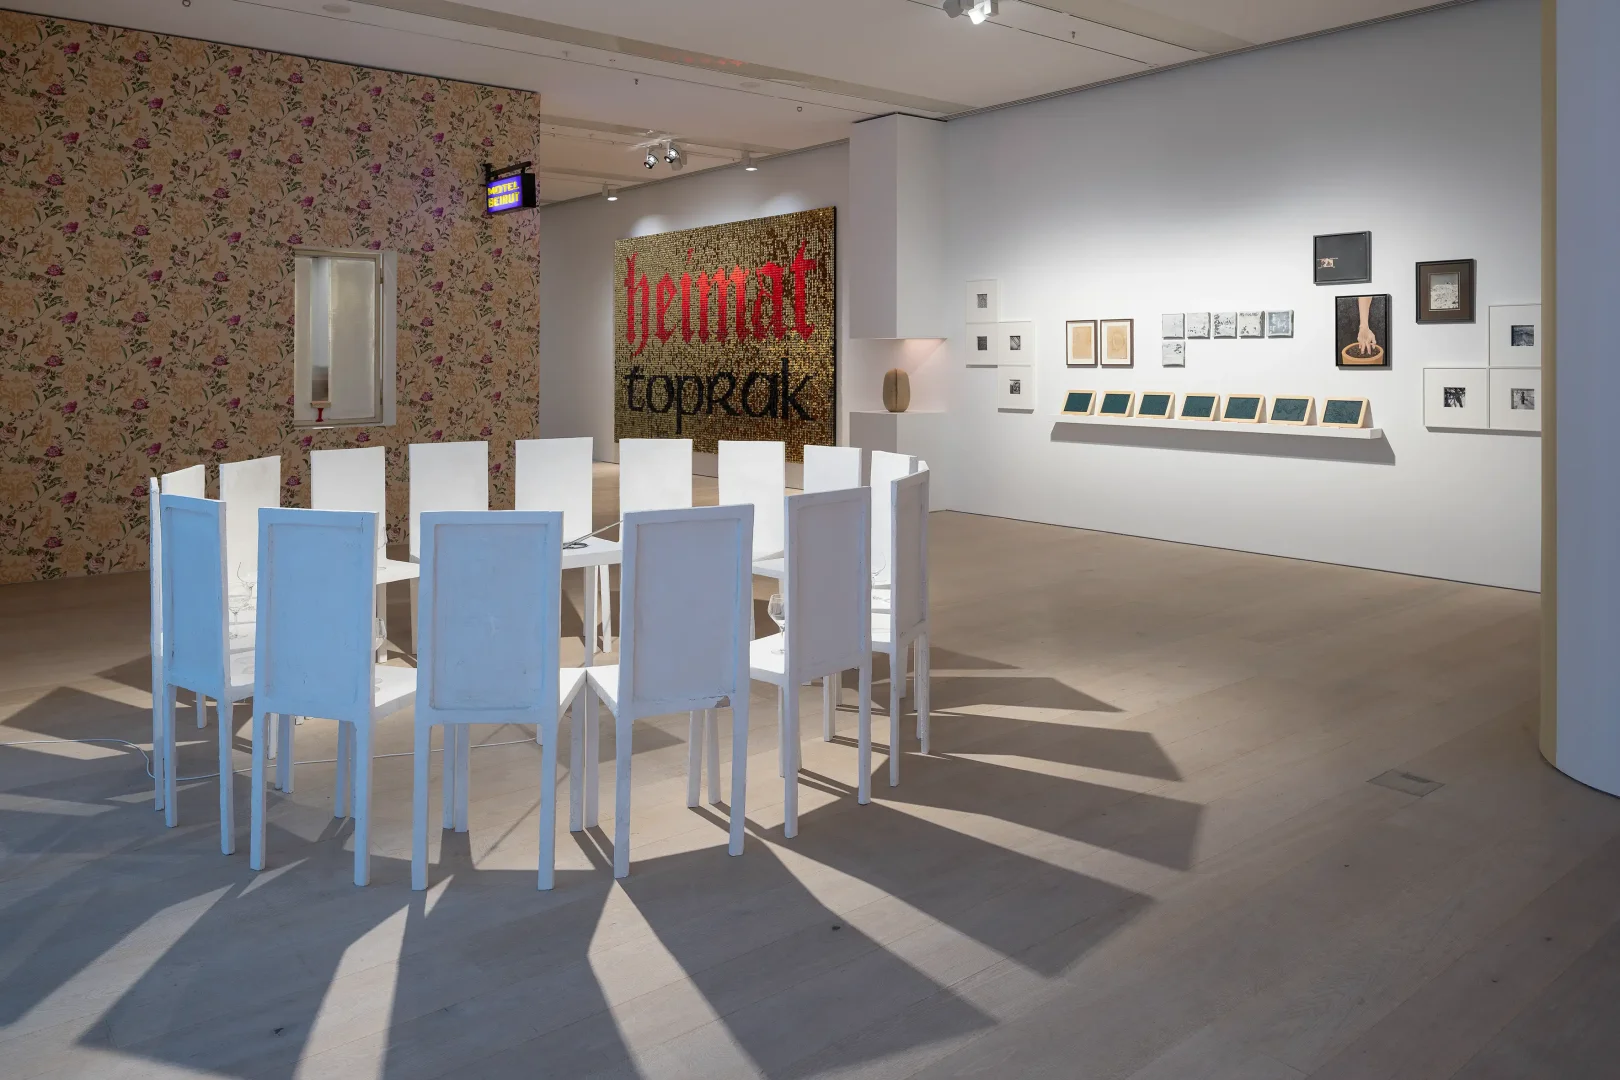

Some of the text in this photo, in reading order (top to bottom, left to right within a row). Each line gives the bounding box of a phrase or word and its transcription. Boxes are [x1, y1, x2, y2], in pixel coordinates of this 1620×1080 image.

[487, 181, 519, 195] MOTEL
[487, 192, 520, 207] BEIRUT
[624, 239, 817, 357] heimat
